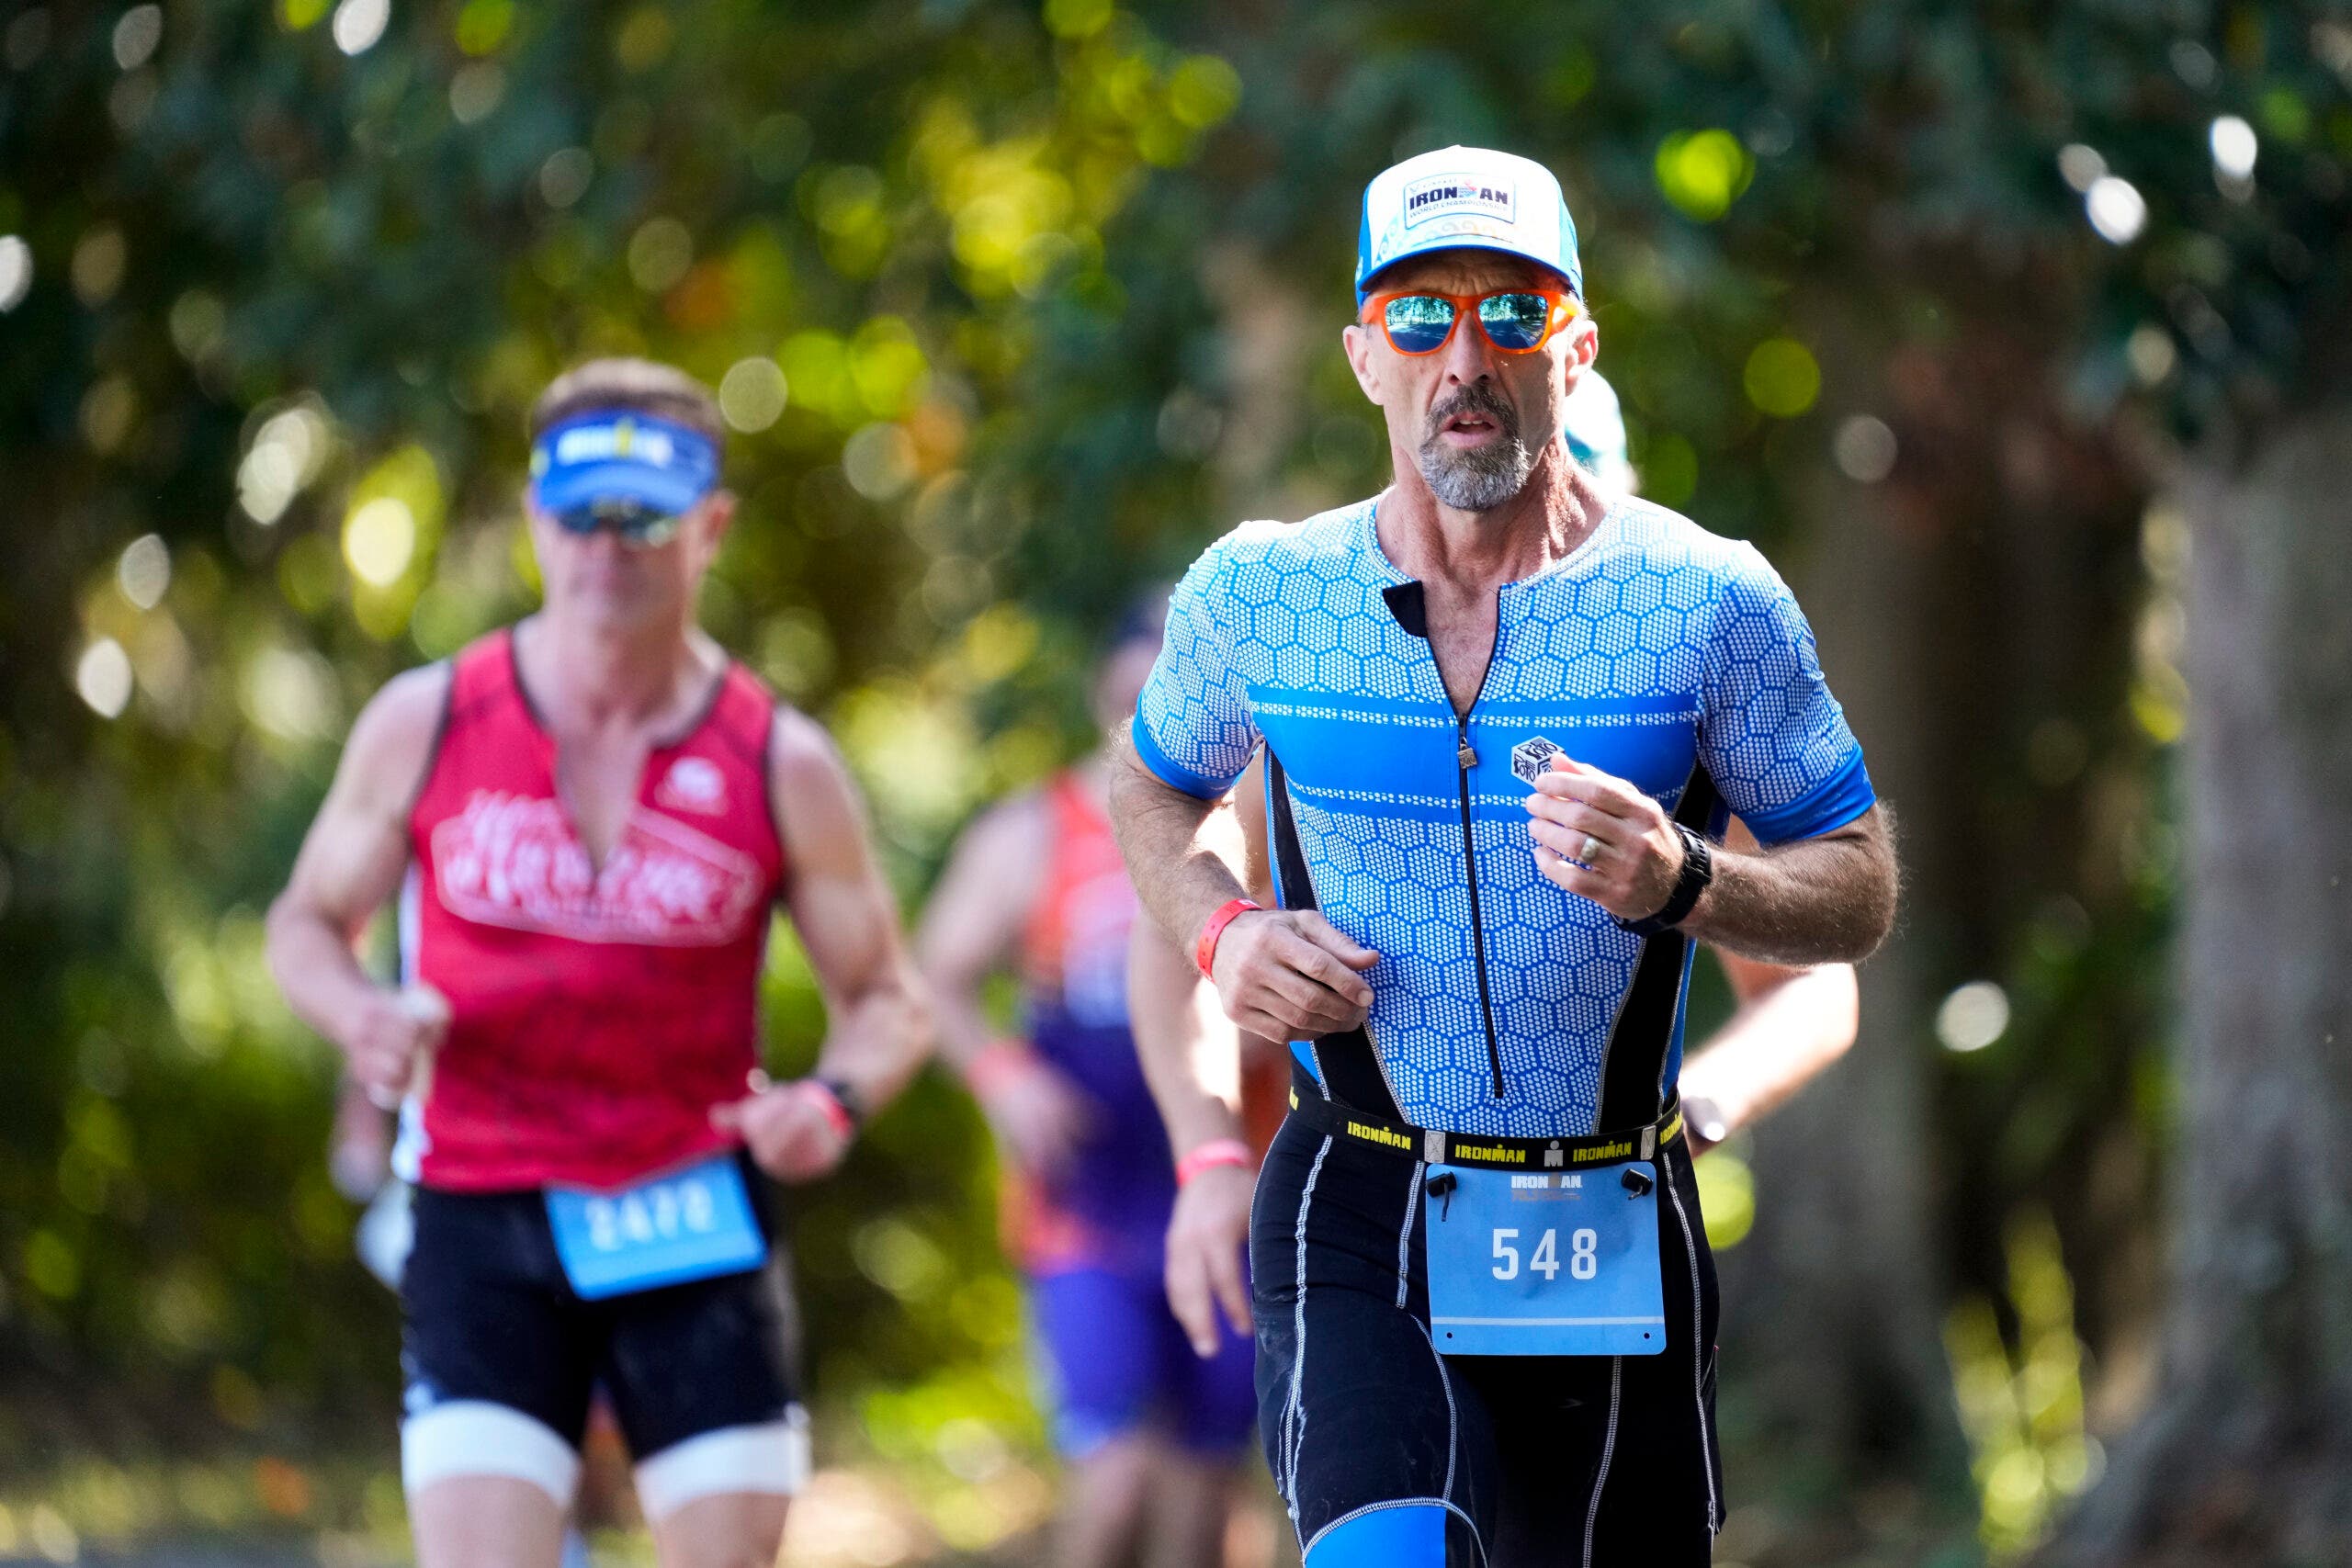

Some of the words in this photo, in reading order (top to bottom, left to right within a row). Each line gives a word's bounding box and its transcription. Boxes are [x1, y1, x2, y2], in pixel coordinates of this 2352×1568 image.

[1347, 1121, 1412, 1151] IRONMAN
[1455, 1144, 1526, 1163] IRONMAN
[1573, 1140, 1633, 1163] IRONMAN
[1492, 1228, 1598, 1280] 548
